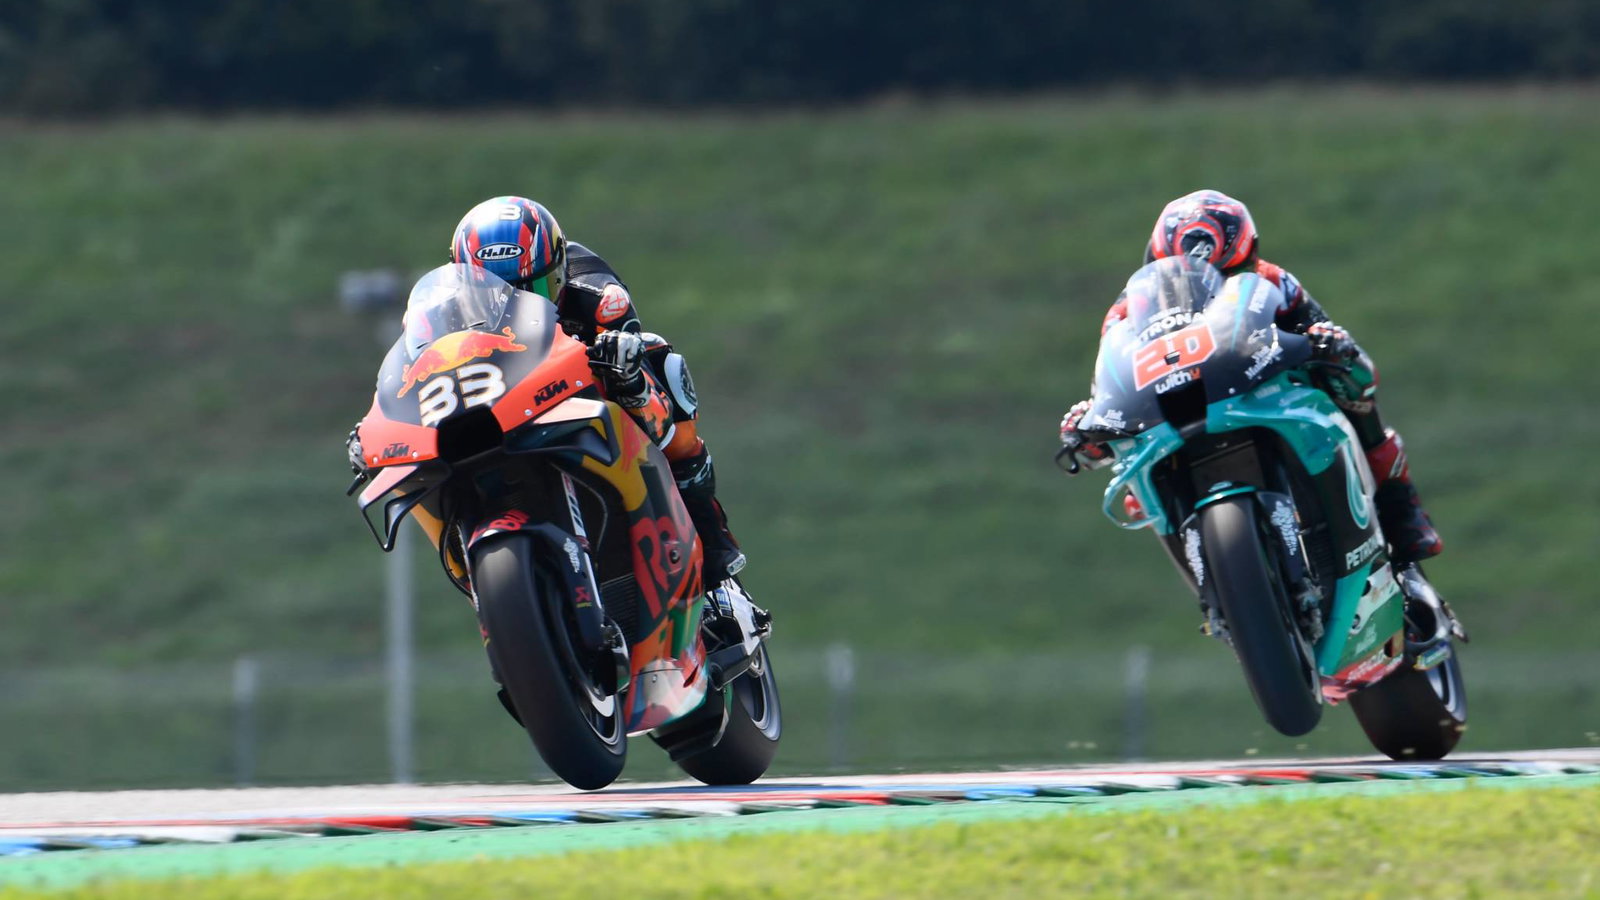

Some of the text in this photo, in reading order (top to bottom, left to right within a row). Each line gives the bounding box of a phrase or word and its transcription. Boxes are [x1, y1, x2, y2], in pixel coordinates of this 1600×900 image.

[480, 246, 519, 258] HJC
[1132, 323, 1217, 391] 20
[418, 363, 506, 427] 33
[534, 379, 569, 406] KTM
[382, 443, 410, 459] KTM
